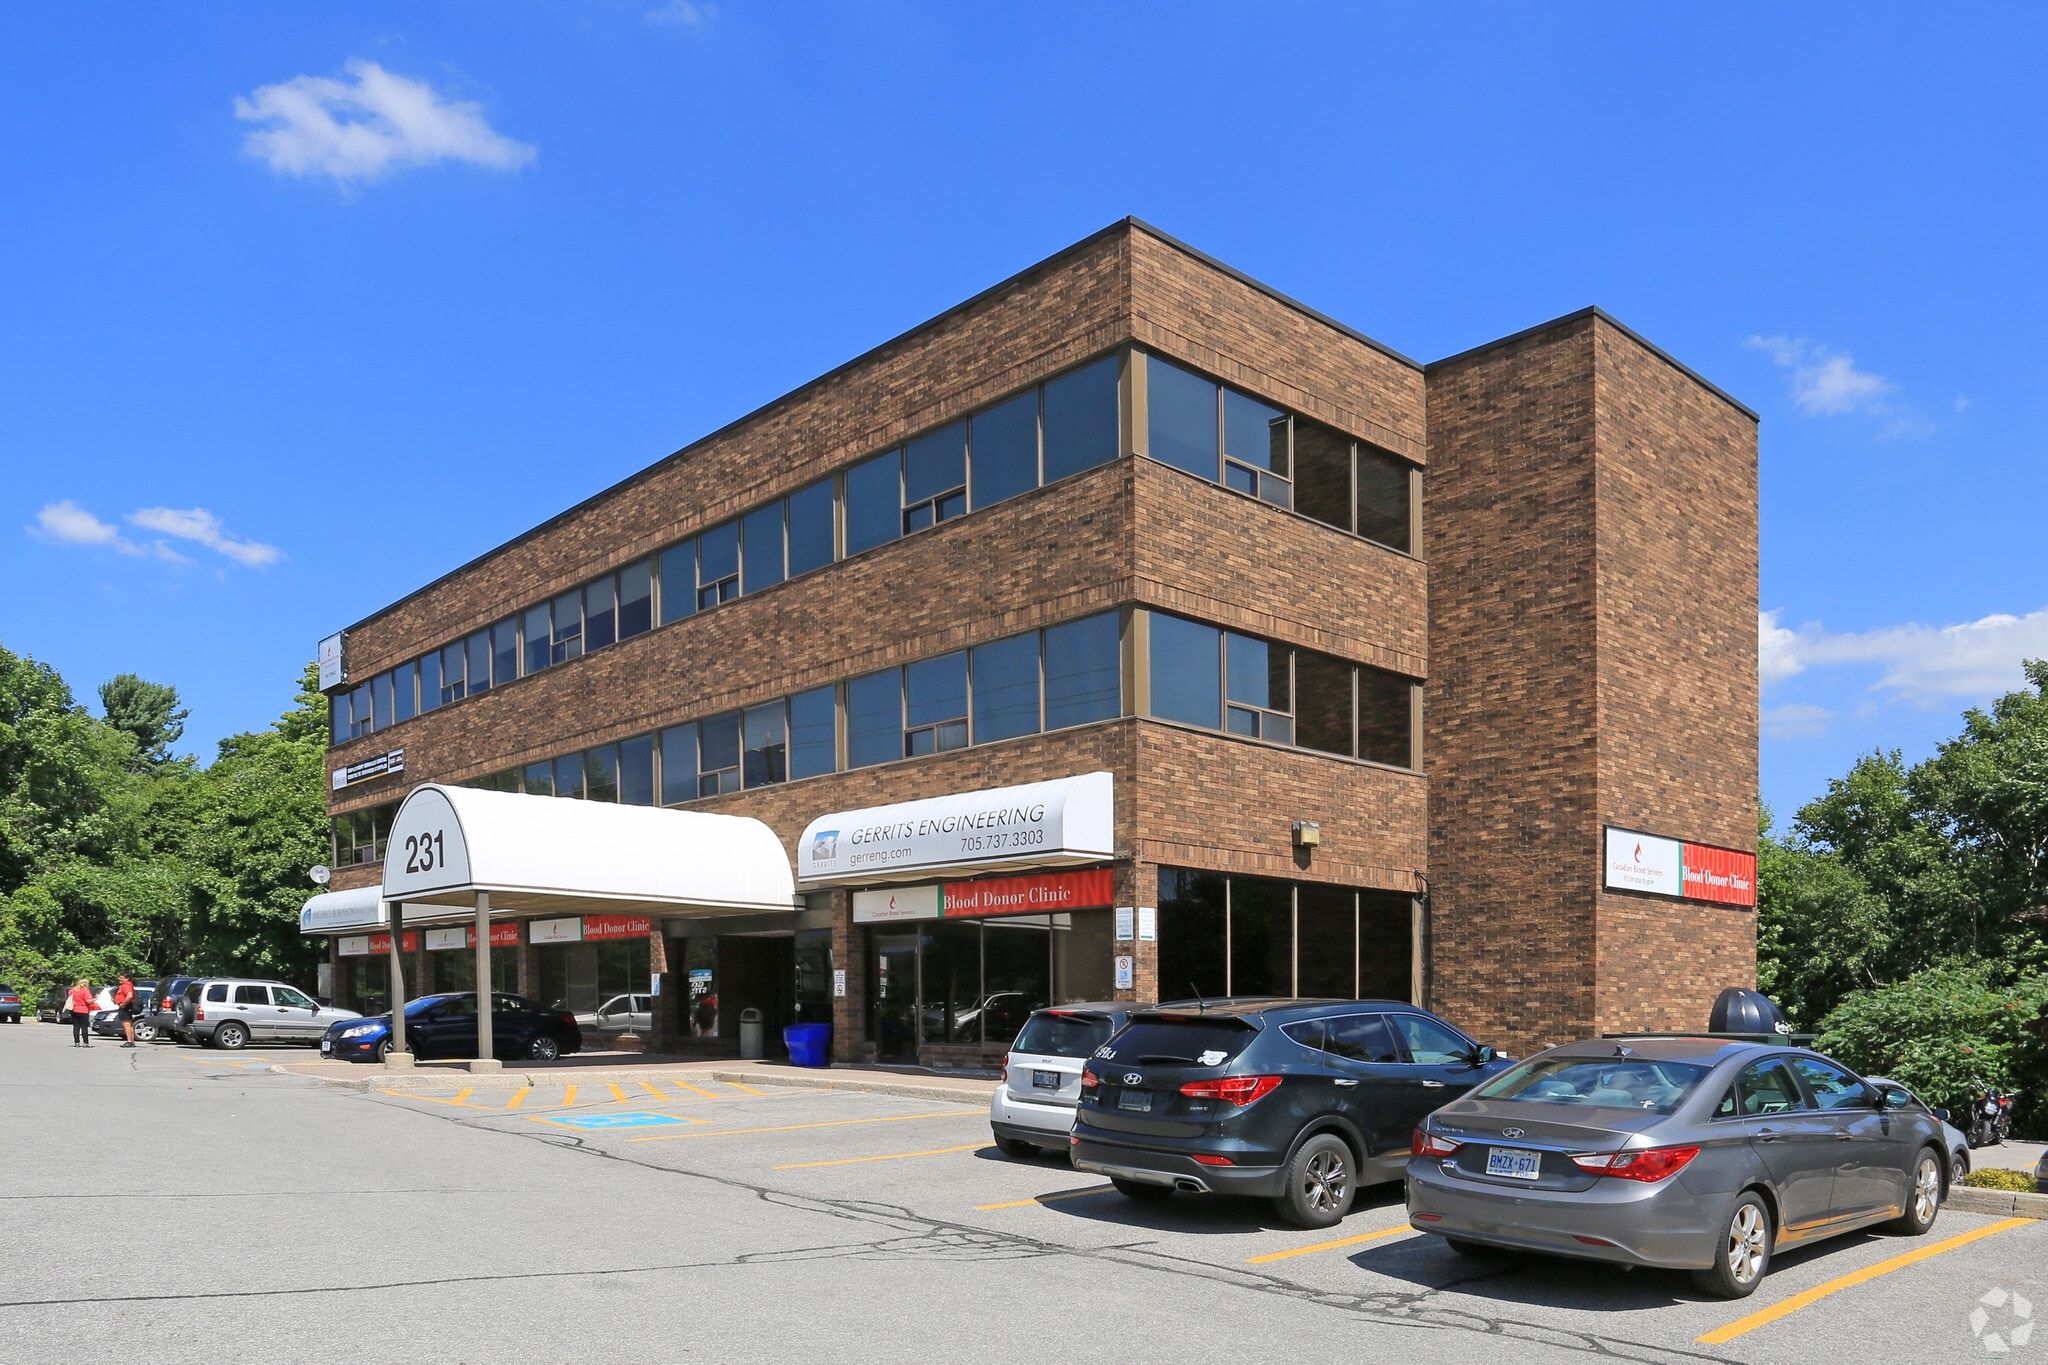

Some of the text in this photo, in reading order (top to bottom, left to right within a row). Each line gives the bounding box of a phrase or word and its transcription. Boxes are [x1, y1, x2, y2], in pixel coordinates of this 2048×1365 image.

[851, 804, 1045, 845] GERRITS ENGINEERING
[405, 829, 444, 874] 231
[961, 829, 1044, 852] 705.737.3303
[811, 860, 837, 869] GERRITS
[850, 847, 912, 867] gerreng.com
[1682, 865, 1750, 891] Blood Donor Clinic
[943, 885, 1071, 911] Blood Donor Clinic
[500, 930, 518, 941] Clinic
[583, 920, 650, 936] Blood Donor Clinic
